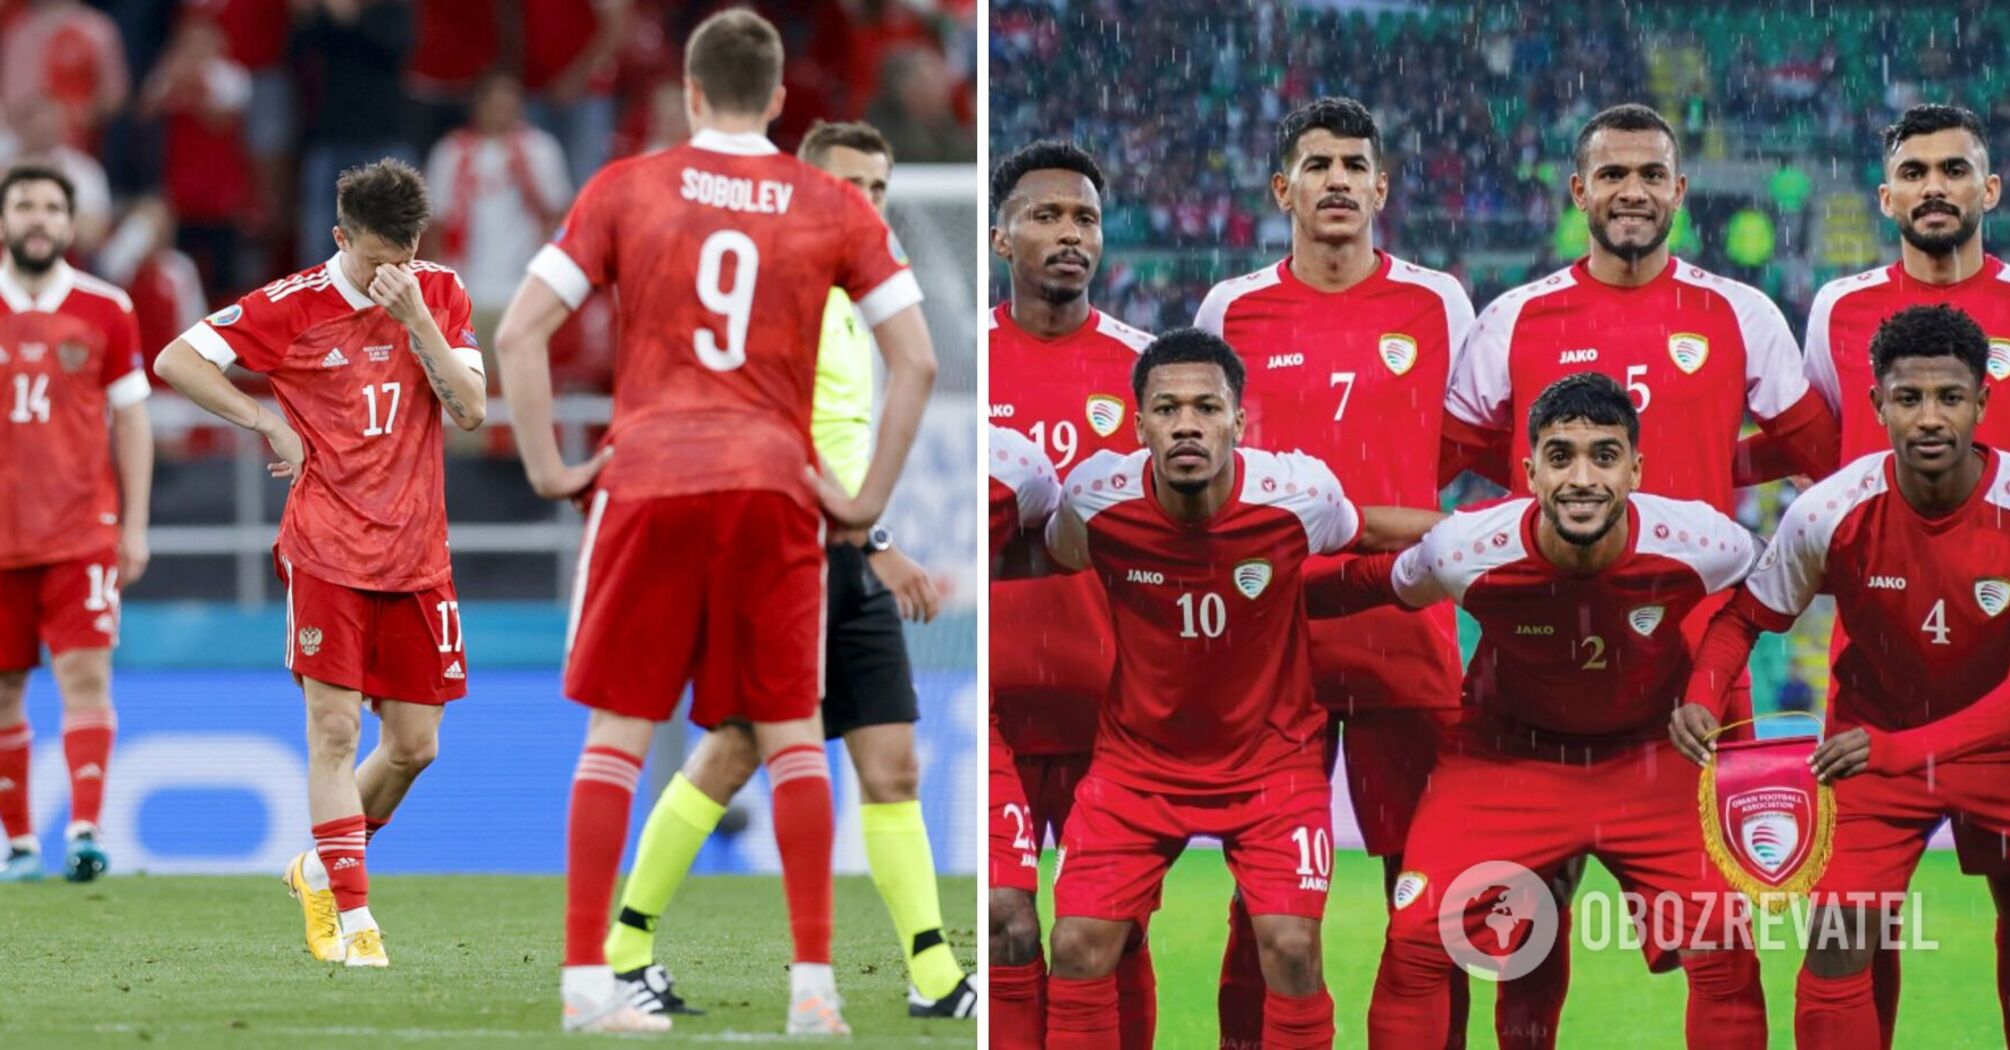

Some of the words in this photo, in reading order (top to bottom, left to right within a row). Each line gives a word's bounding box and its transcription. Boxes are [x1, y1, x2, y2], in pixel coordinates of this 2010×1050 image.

[680, 167, 794, 215] SOBOLEV
[693, 229, 759, 371] 9
[1267, 353, 1304, 369] JAKO
[1558, 348, 1598, 364] JAKO
[10, 373, 51, 423] 14
[362, 381, 401, 437] 17
[1330, 372, 1356, 421] 7
[1626, 364, 1651, 414] 5
[1029, 420, 1078, 470] 19
[84, 563, 120, 612] 14
[1127, 569, 1164, 585] JAKO
[1868, 575, 1907, 590] JAKO
[436, 600, 462, 652] 17
[1176, 592, 1226, 638] 10
[1515, 624, 1555, 635] JAKO
[1921, 598, 1951, 644] 4
[1581, 636, 1607, 669] 2
[1732, 795, 1759, 808] OMAN
[1759, 793, 1803, 803] FOOTBALL
[1742, 801, 1794, 813] ASSOCIATION
[1291, 826, 1330, 877] 10
